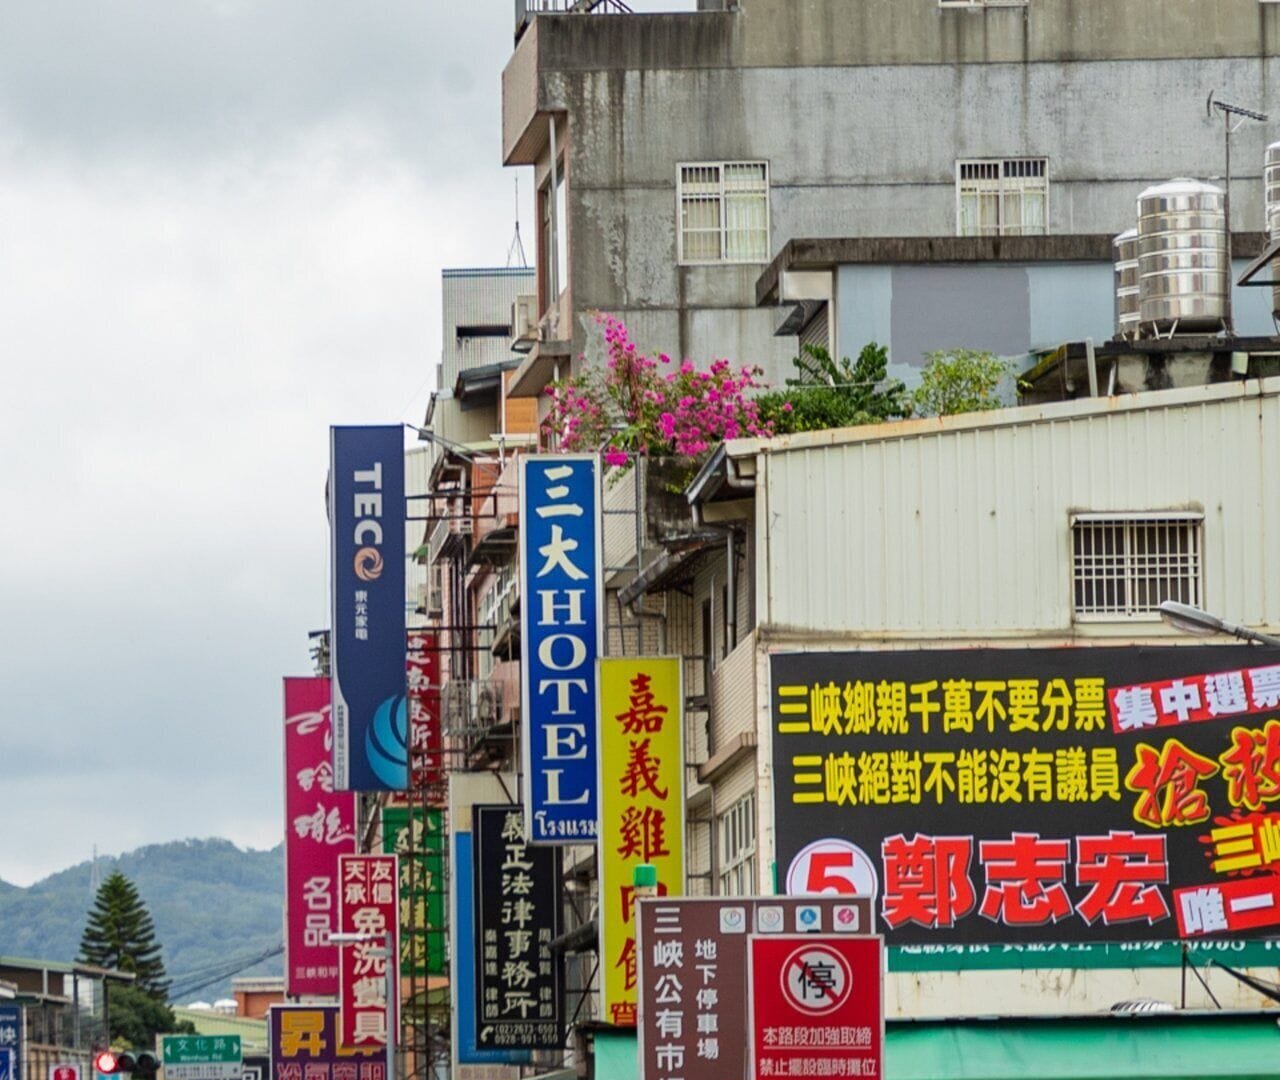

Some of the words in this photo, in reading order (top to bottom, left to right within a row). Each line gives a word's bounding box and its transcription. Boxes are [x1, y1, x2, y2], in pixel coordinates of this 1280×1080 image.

[353, 461, 384, 581] TECO
[777, 677, 1107, 736] 三峽鄉親千萬不要分票
[791, 747, 1122, 806] 三峽絕對不能沒有議員
[344, 860, 367, 905] 天承
[371, 860, 394, 905] 友信
[879, 830, 1172, 929] 鄭志宏
[501, 811, 537, 1019] 義正法律事務所
[350, 906, 388, 1044] 免洗餐具
[694, 938, 720, 1061] 地下停車場
[797, 961, 839, 1000] 停
[177, 1039, 227, 1051] 文化路
[762, 1027, 872, 1047] 本路段加強取締
[759, 1058, 877, 1077] 禁止擺設臨時攤位
